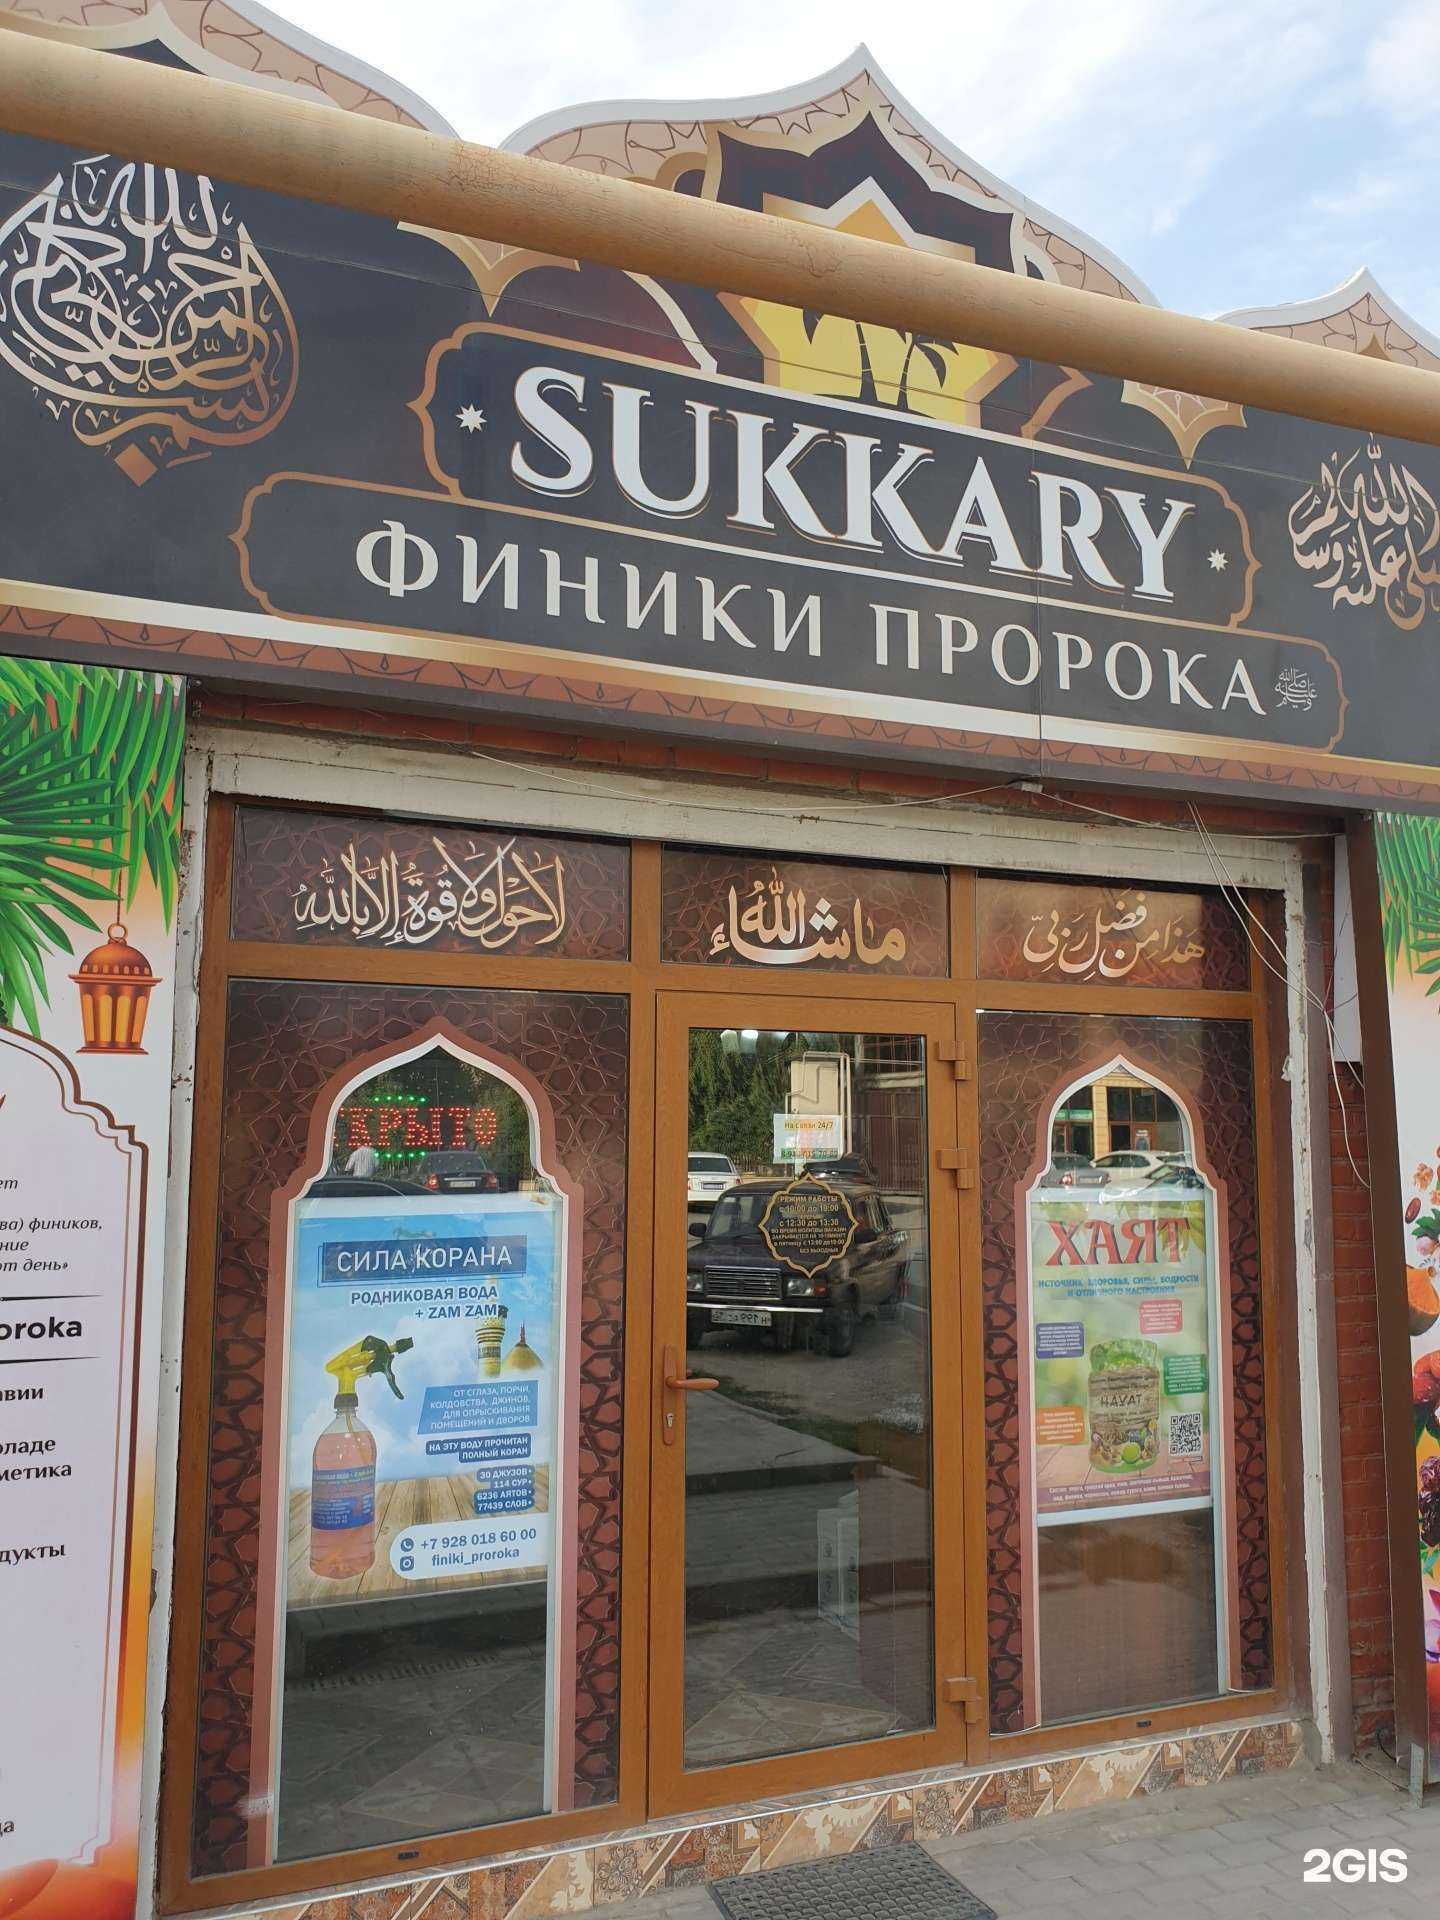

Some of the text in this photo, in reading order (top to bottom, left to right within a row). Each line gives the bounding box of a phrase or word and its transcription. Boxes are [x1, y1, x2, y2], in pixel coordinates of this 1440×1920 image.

[509, 365, 1196, 604] SUKKARY
[355, 520, 1268, 716] ФИНИКИ ПРОРОКА
[333, 1107, 497, 1147] КРЫТО
[817, 1120, 834, 1130] 24/7
[28, 1217, 102, 1234] фиников,
[786, 1219, 806, 1227] 12:30
[1046, 1216, 1191, 1267] ХАЯТ
[22, 1258, 69, 1272] день»
[337, 1244, 513, 1273] СИЛА КОРАНА
[1159, 1273, 1200, 1284] БОДРОСТИ
[351, 1285, 499, 1306] РОДНИКОВАЯ ВОДА
[428, 1306, 461, 1319] ZAM
[465, 1304, 498, 1318] ZAM
[453, 1388, 465, 1398] ОТ
[443, 1405, 531, 1420] ДЛЯ ОПРЫСКИВАНИЯ
[496, 1414, 530, 1425] ДВОРОВ
[429, 1436, 528, 1452] НА ЭТУ ВОДУ ПРОЧИТАН
[462, 1446, 528, 1459] ПОЛНЫЙ КОРАН
[480, 1468, 528, 1480] 30 ДЖУЗОВ
[494, 1478, 527, 1489] 114 СУР
[500, 1488, 528, 1498] АЯТОВ
[477, 1498, 527, 1511] 77439 СЛОВ
[421, 1527, 537, 1550] +7 928 018 60 00
[431, 1547, 520, 1567] finiki_proroka
